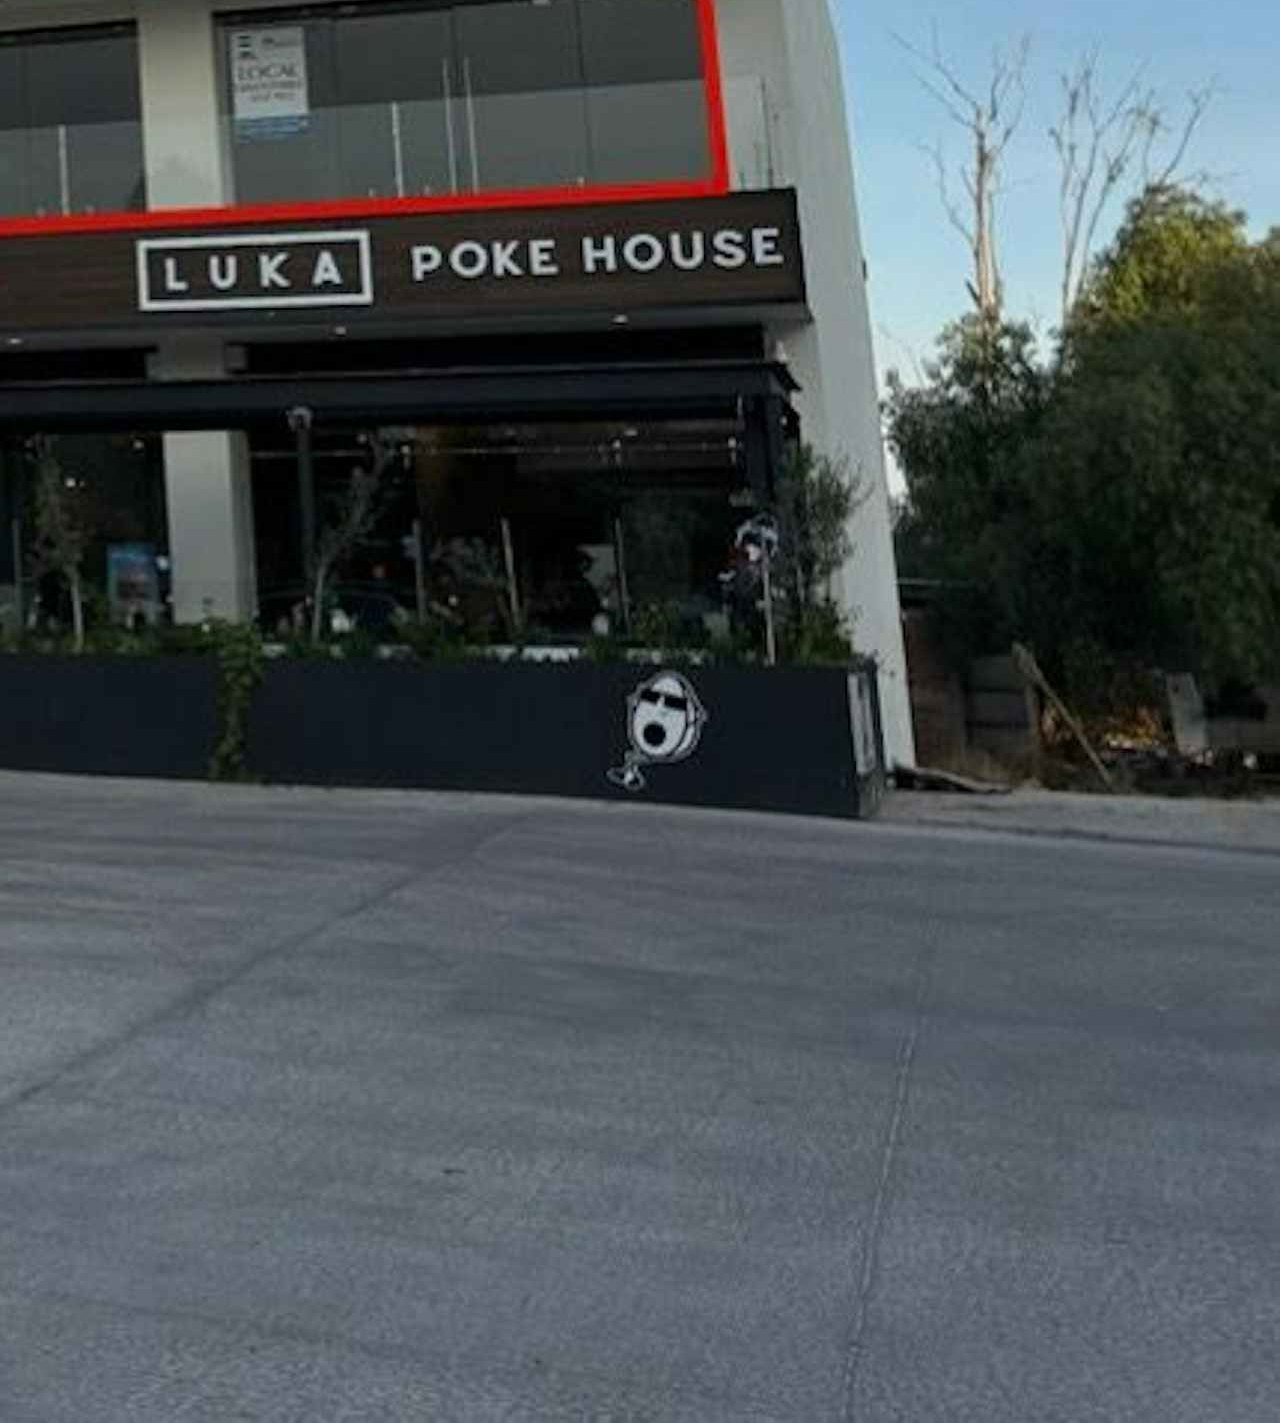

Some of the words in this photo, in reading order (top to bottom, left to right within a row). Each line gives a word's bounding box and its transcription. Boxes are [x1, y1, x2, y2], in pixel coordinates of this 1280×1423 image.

[165, 250, 343, 291] LUKA
[412, 239, 558, 281] POKE
[582, 227, 783, 273] HOUSE
